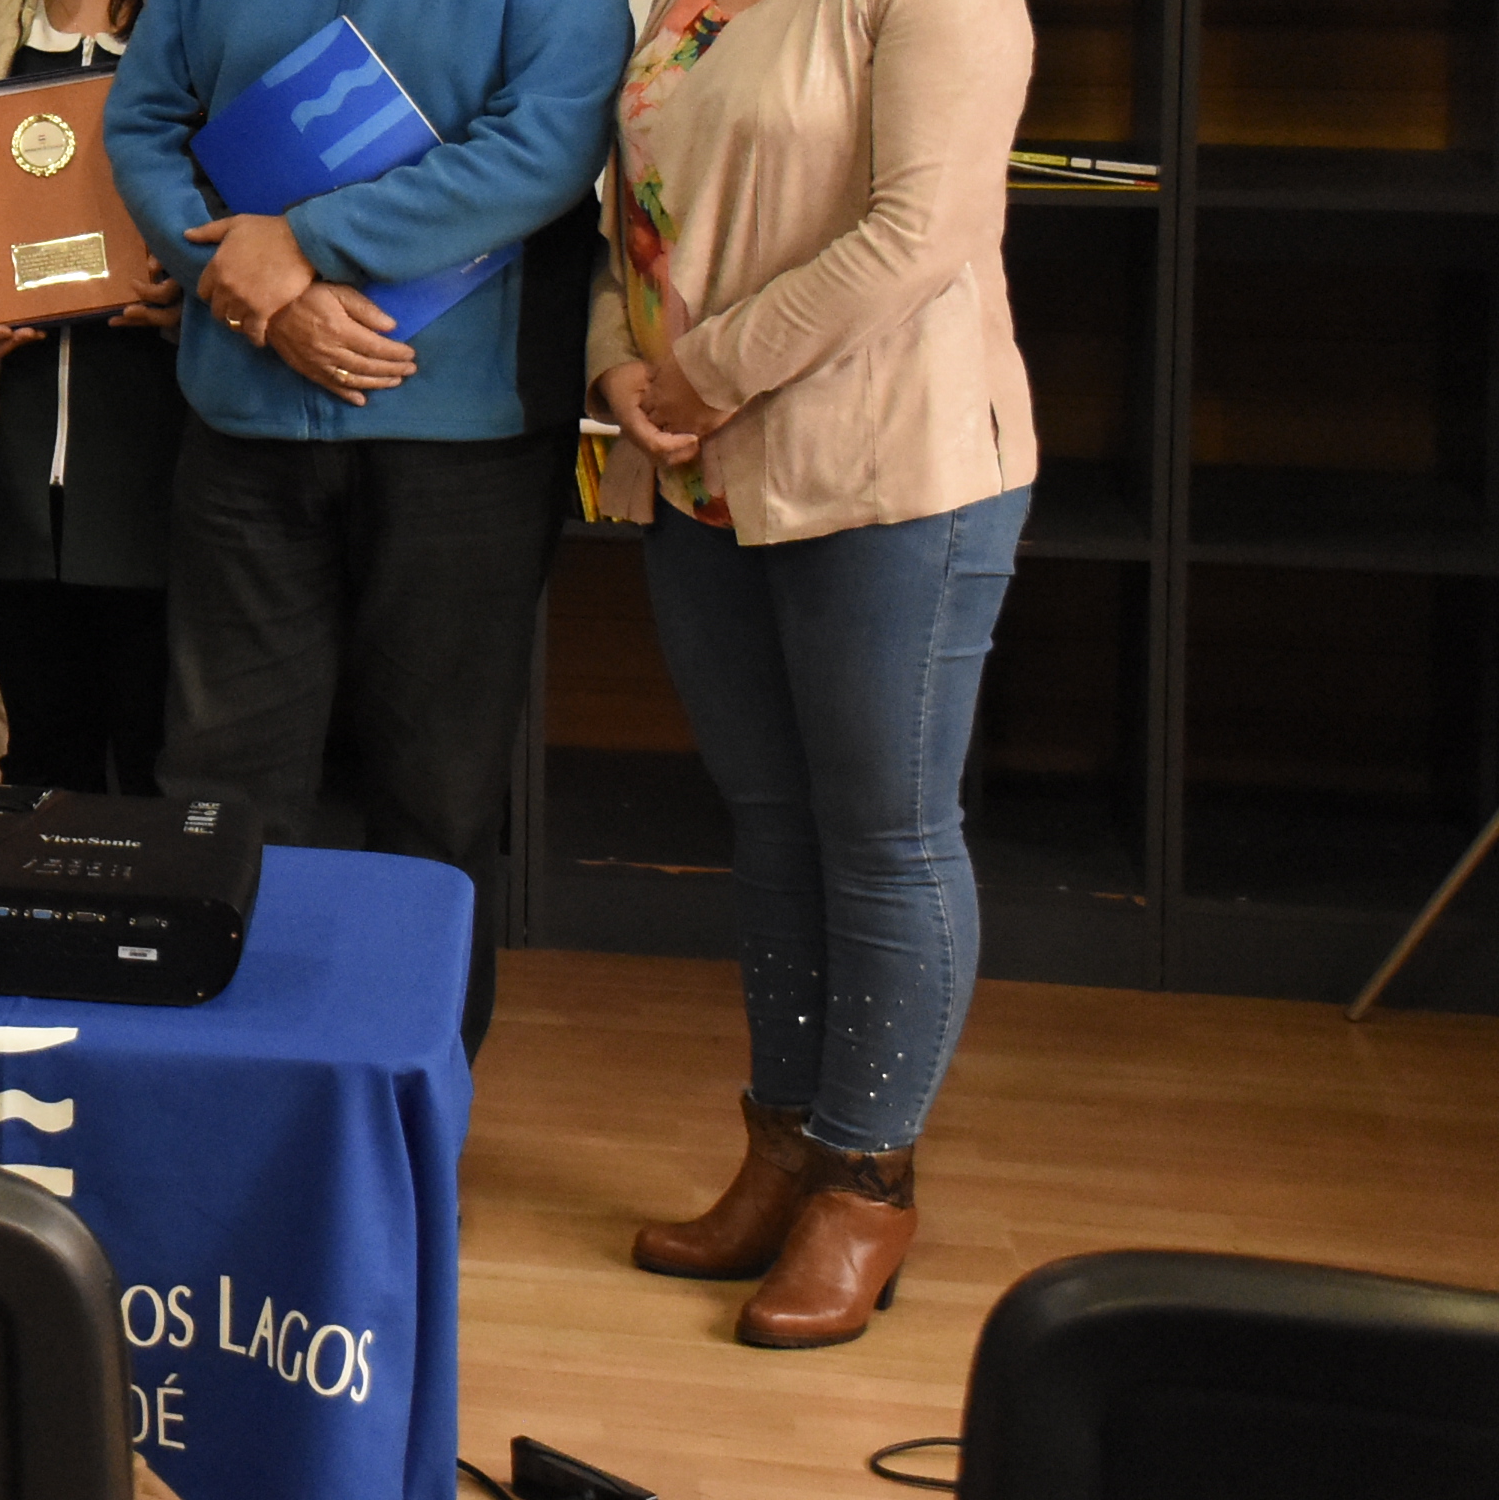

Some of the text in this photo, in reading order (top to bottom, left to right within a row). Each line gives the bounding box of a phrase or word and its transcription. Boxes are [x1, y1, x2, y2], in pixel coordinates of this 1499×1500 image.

[39, 833, 142, 847] ViewSonic
[120, 1274, 373, 1403] OS LAGOS
